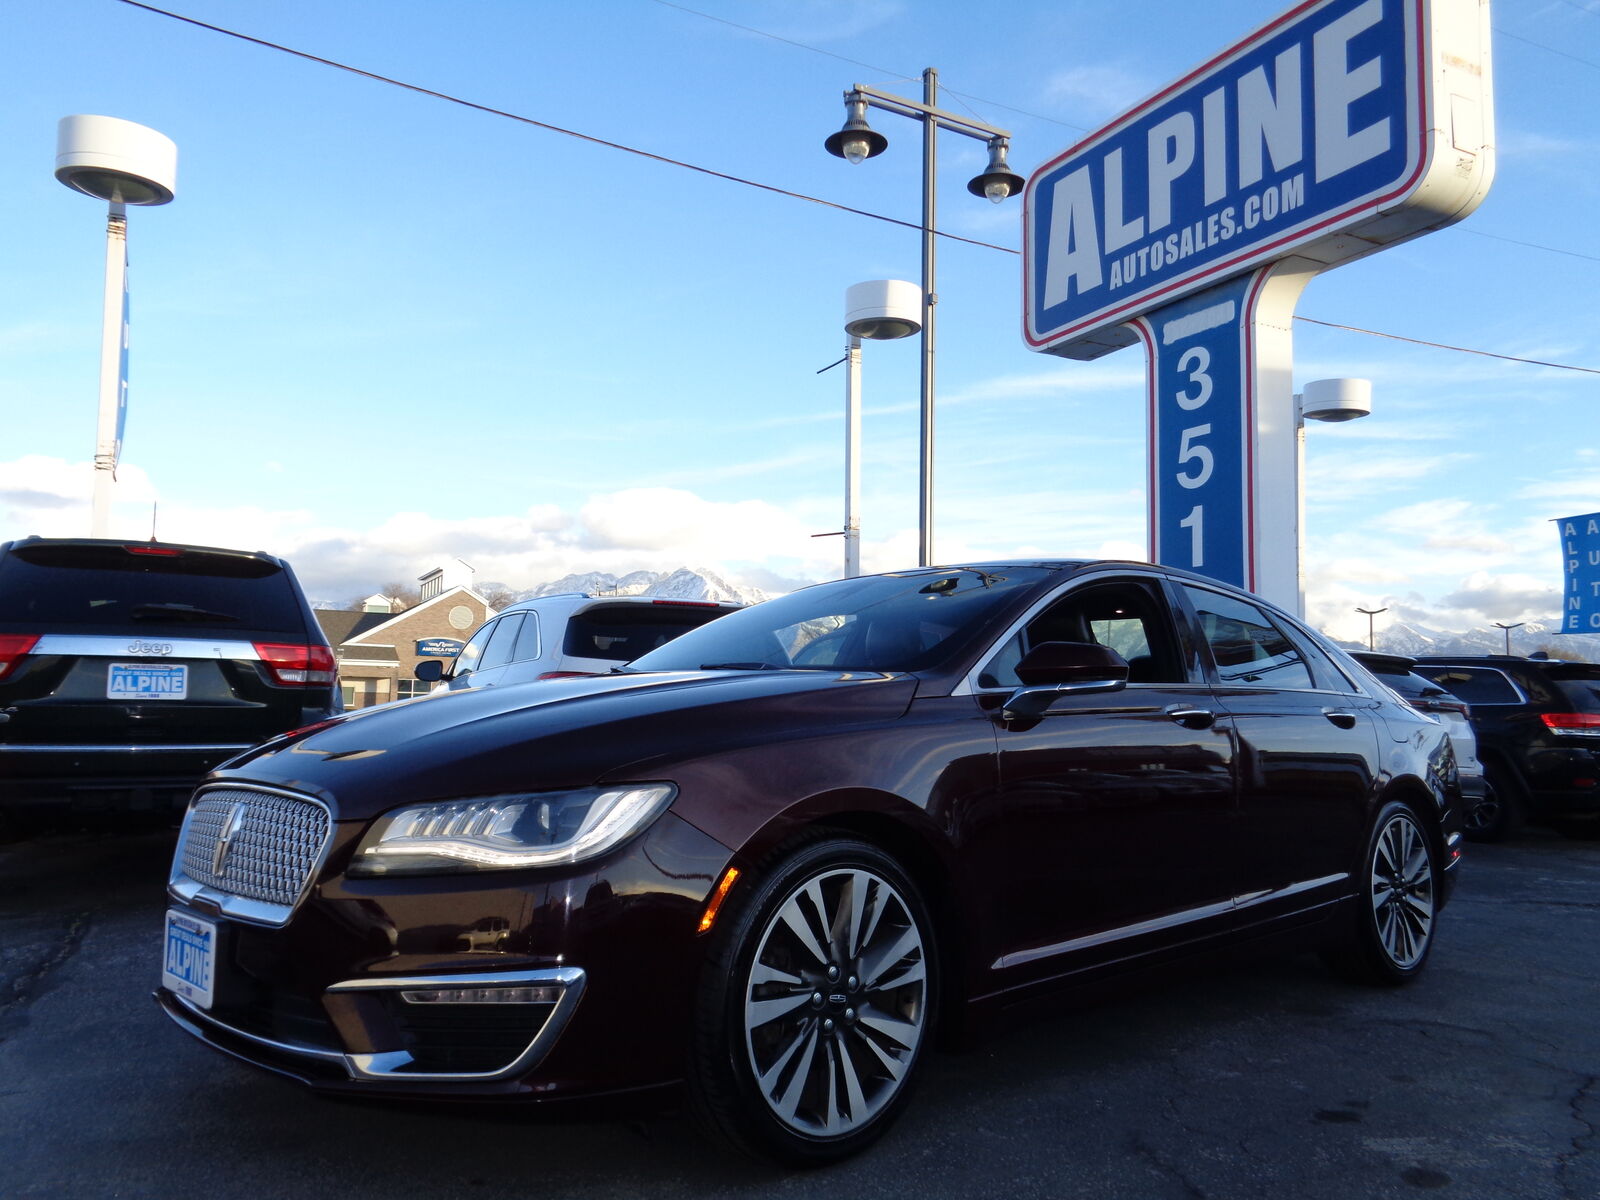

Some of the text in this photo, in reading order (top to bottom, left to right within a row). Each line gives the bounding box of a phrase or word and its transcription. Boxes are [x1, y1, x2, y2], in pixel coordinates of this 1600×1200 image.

[1043, 0, 1391, 310] ALPINE
[1109, 173, 1304, 291] AUTOSALES.COM
[1565, 522, 1581, 629] ALPINE
[112, 675, 184, 693] ALPINE
[128, 640, 173, 656] Jeep
[167, 938, 210, 992] ALPINE
